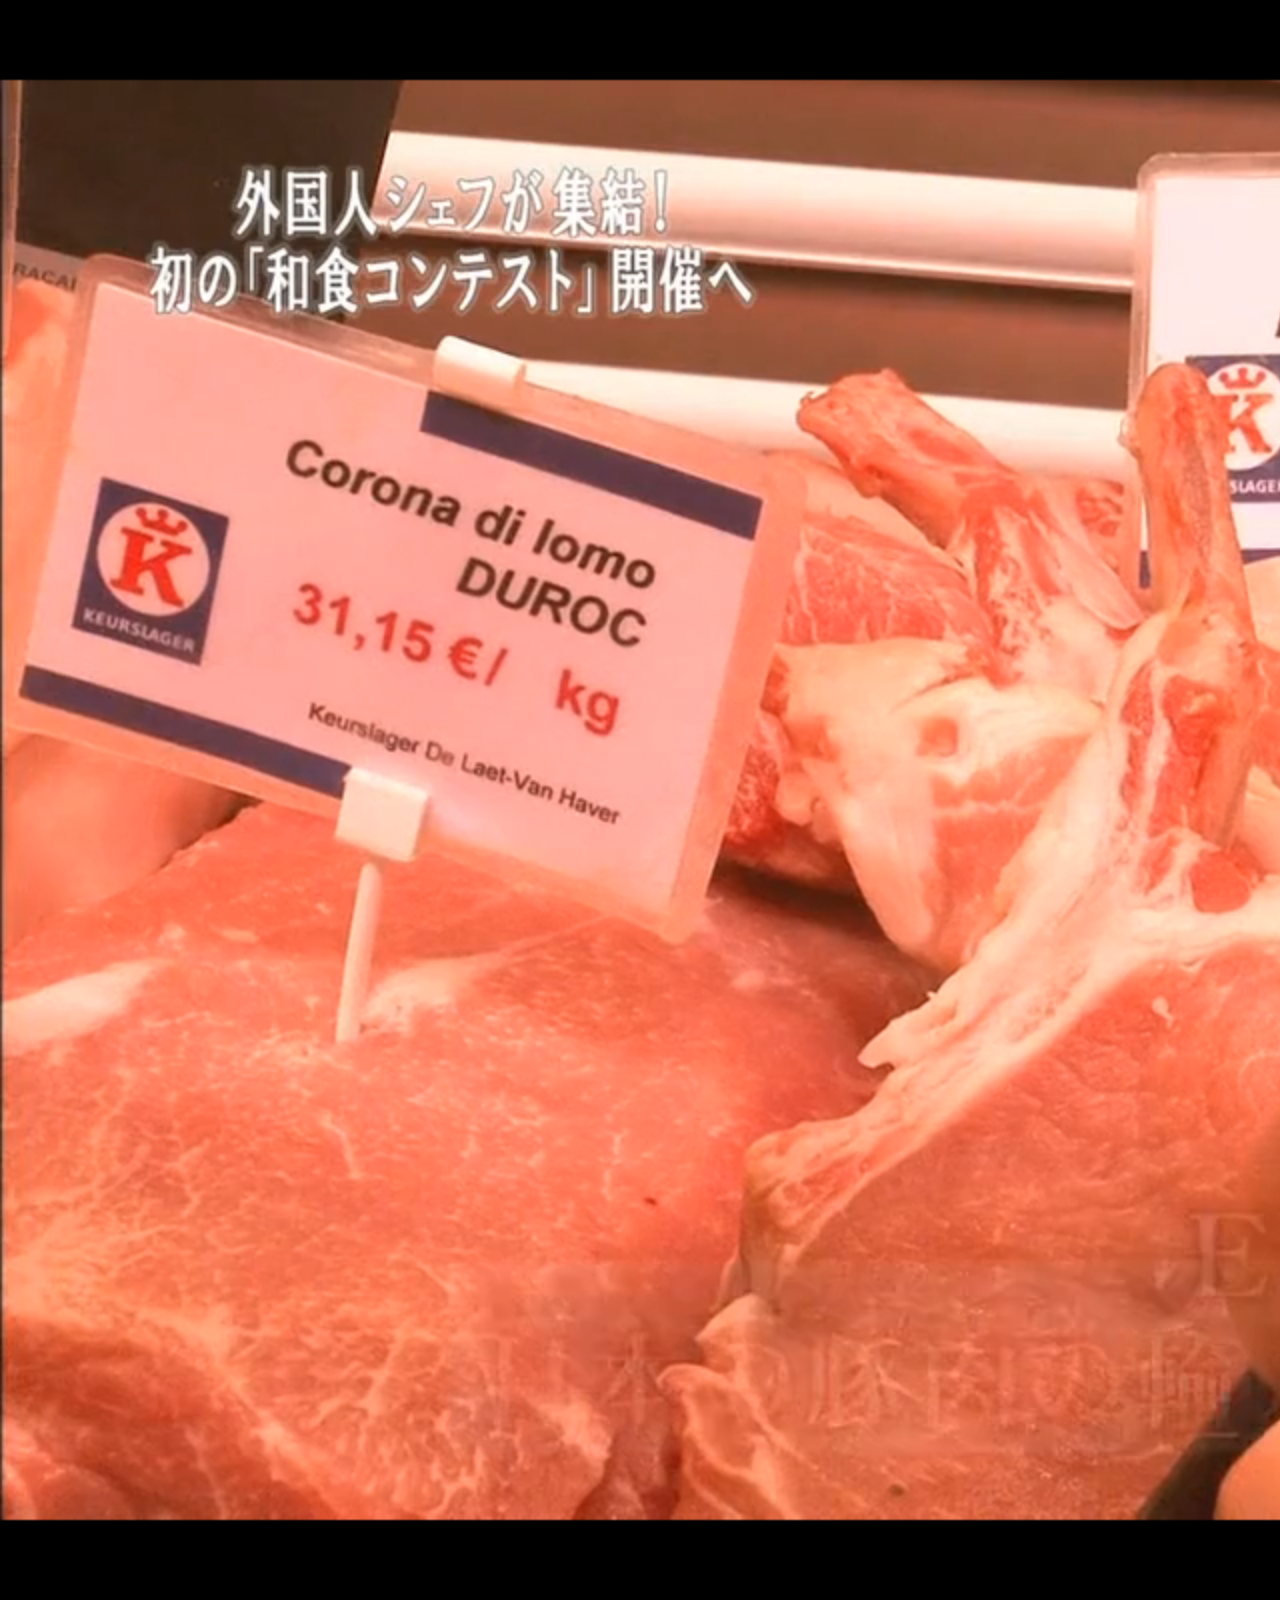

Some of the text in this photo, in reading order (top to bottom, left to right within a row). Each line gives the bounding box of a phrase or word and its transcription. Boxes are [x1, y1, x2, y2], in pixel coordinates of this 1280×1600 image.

[286, 440, 656, 589] Corona di lomo
[82, 608, 196, 653] KEURSLAGER
[292, 583, 436, 664] 31,15
[555, 668, 621, 736] kg
[456, 557, 647, 648] DUROC
[308, 703, 620, 825] Keurslager De Laet-Van Haver
